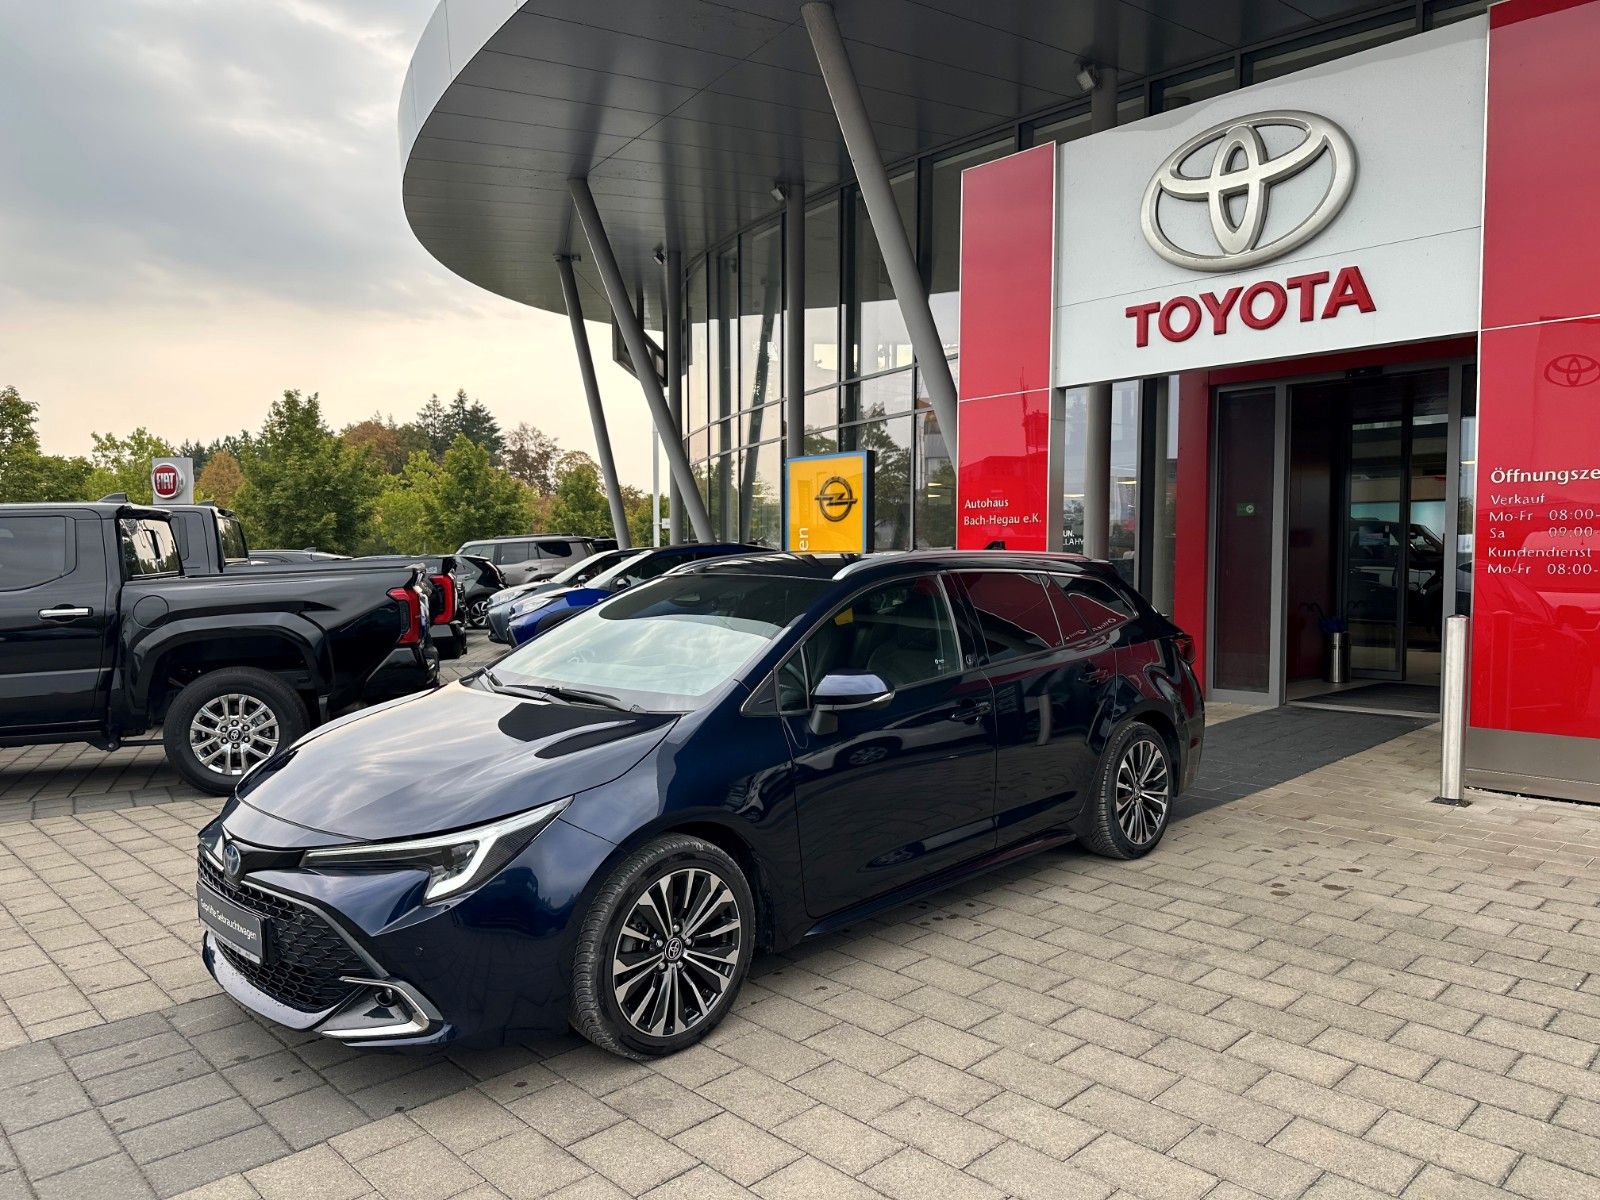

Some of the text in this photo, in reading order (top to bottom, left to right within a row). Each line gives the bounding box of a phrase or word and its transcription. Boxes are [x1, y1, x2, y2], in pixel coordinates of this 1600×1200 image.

[1125, 266, 1377, 347] TOYOTA
[156, 472, 175, 490] FIAT
[964, 498, 1009, 509] Autohaus
[1490, 493, 1545, 505] Verkauf
[963, 512, 1042, 527] Bach-Hegau e.K.
[1489, 510, 1533, 521] Mo-Fr
[1489, 527, 1505, 538] Sa
[1488, 546, 1592, 558] Kundendienst
[1487, 562, 1531, 574] Mo-Fr
